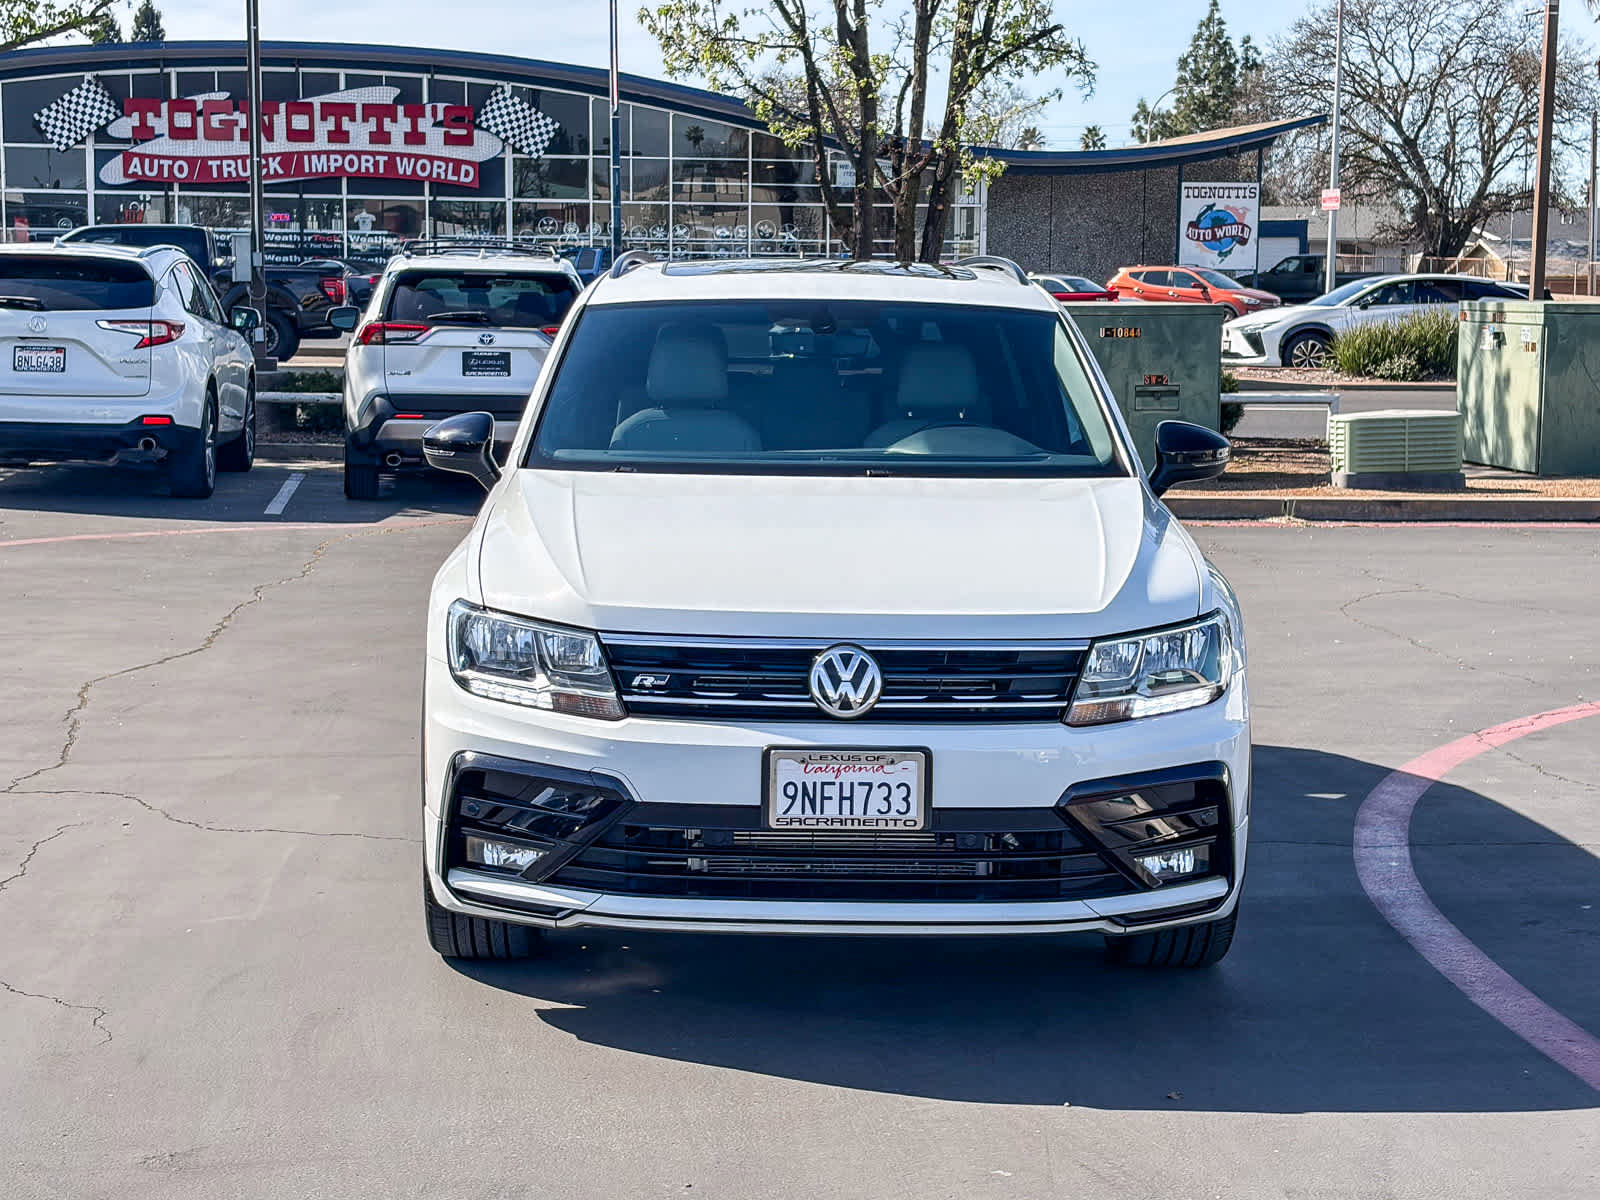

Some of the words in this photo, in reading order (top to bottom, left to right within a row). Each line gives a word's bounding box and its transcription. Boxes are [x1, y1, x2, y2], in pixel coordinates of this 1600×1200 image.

[124, 98, 474, 146] TOGNOTTI'S
[127, 156, 189, 179] AUTO
[303, 154, 389, 174] IMPORT
[396, 156, 475, 183] WORLD
[1184, 185, 1257, 199] TOGNOTTI'S
[1187, 227, 1212, 241] AUTO
[1215, 224, 1250, 239] WORLD
[17, 355, 62, 369] 8NLG438
[1144, 375, 1168, 385] SW-2
[808, 754, 862, 762] LEXUS
[865, 754, 887, 762] OF
[803, 763, 895, 780] California
[782, 780, 912, 816] 9NFH733
[775, 817, 918, 828] SACRAMENTO
